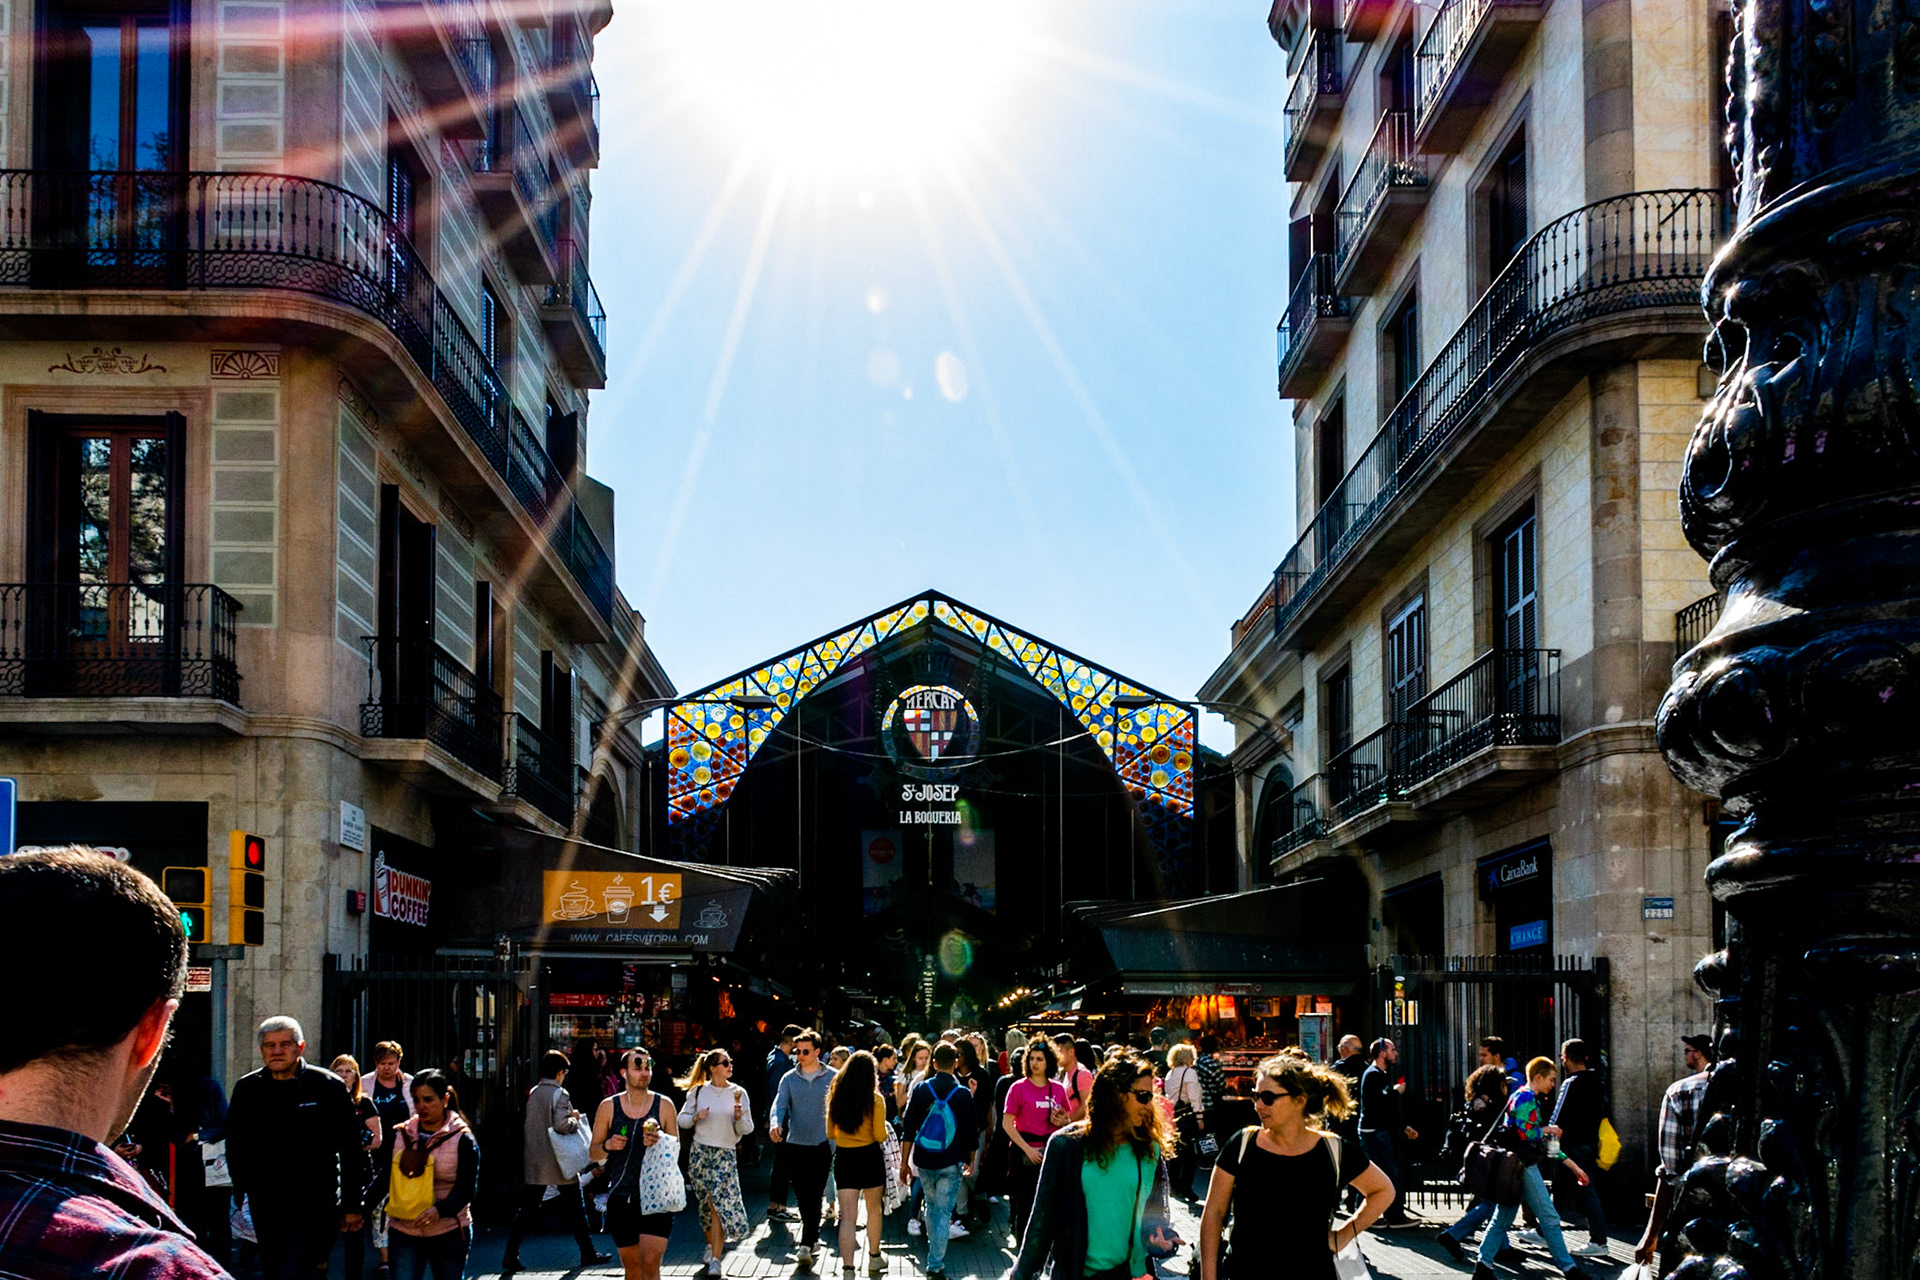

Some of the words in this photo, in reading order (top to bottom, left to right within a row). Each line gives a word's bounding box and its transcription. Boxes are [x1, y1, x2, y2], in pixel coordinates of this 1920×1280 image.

[906, 691, 957, 709] MERCAT
[900, 810, 913, 824] LA
[915, 810, 962, 824] BOQUERIA
[1500, 856, 1539, 882] CaixaBank
[640, 876, 675, 906] 1€
[391, 894, 429, 926] COFFEE
[1510, 926, 1544, 945] CHANGE
